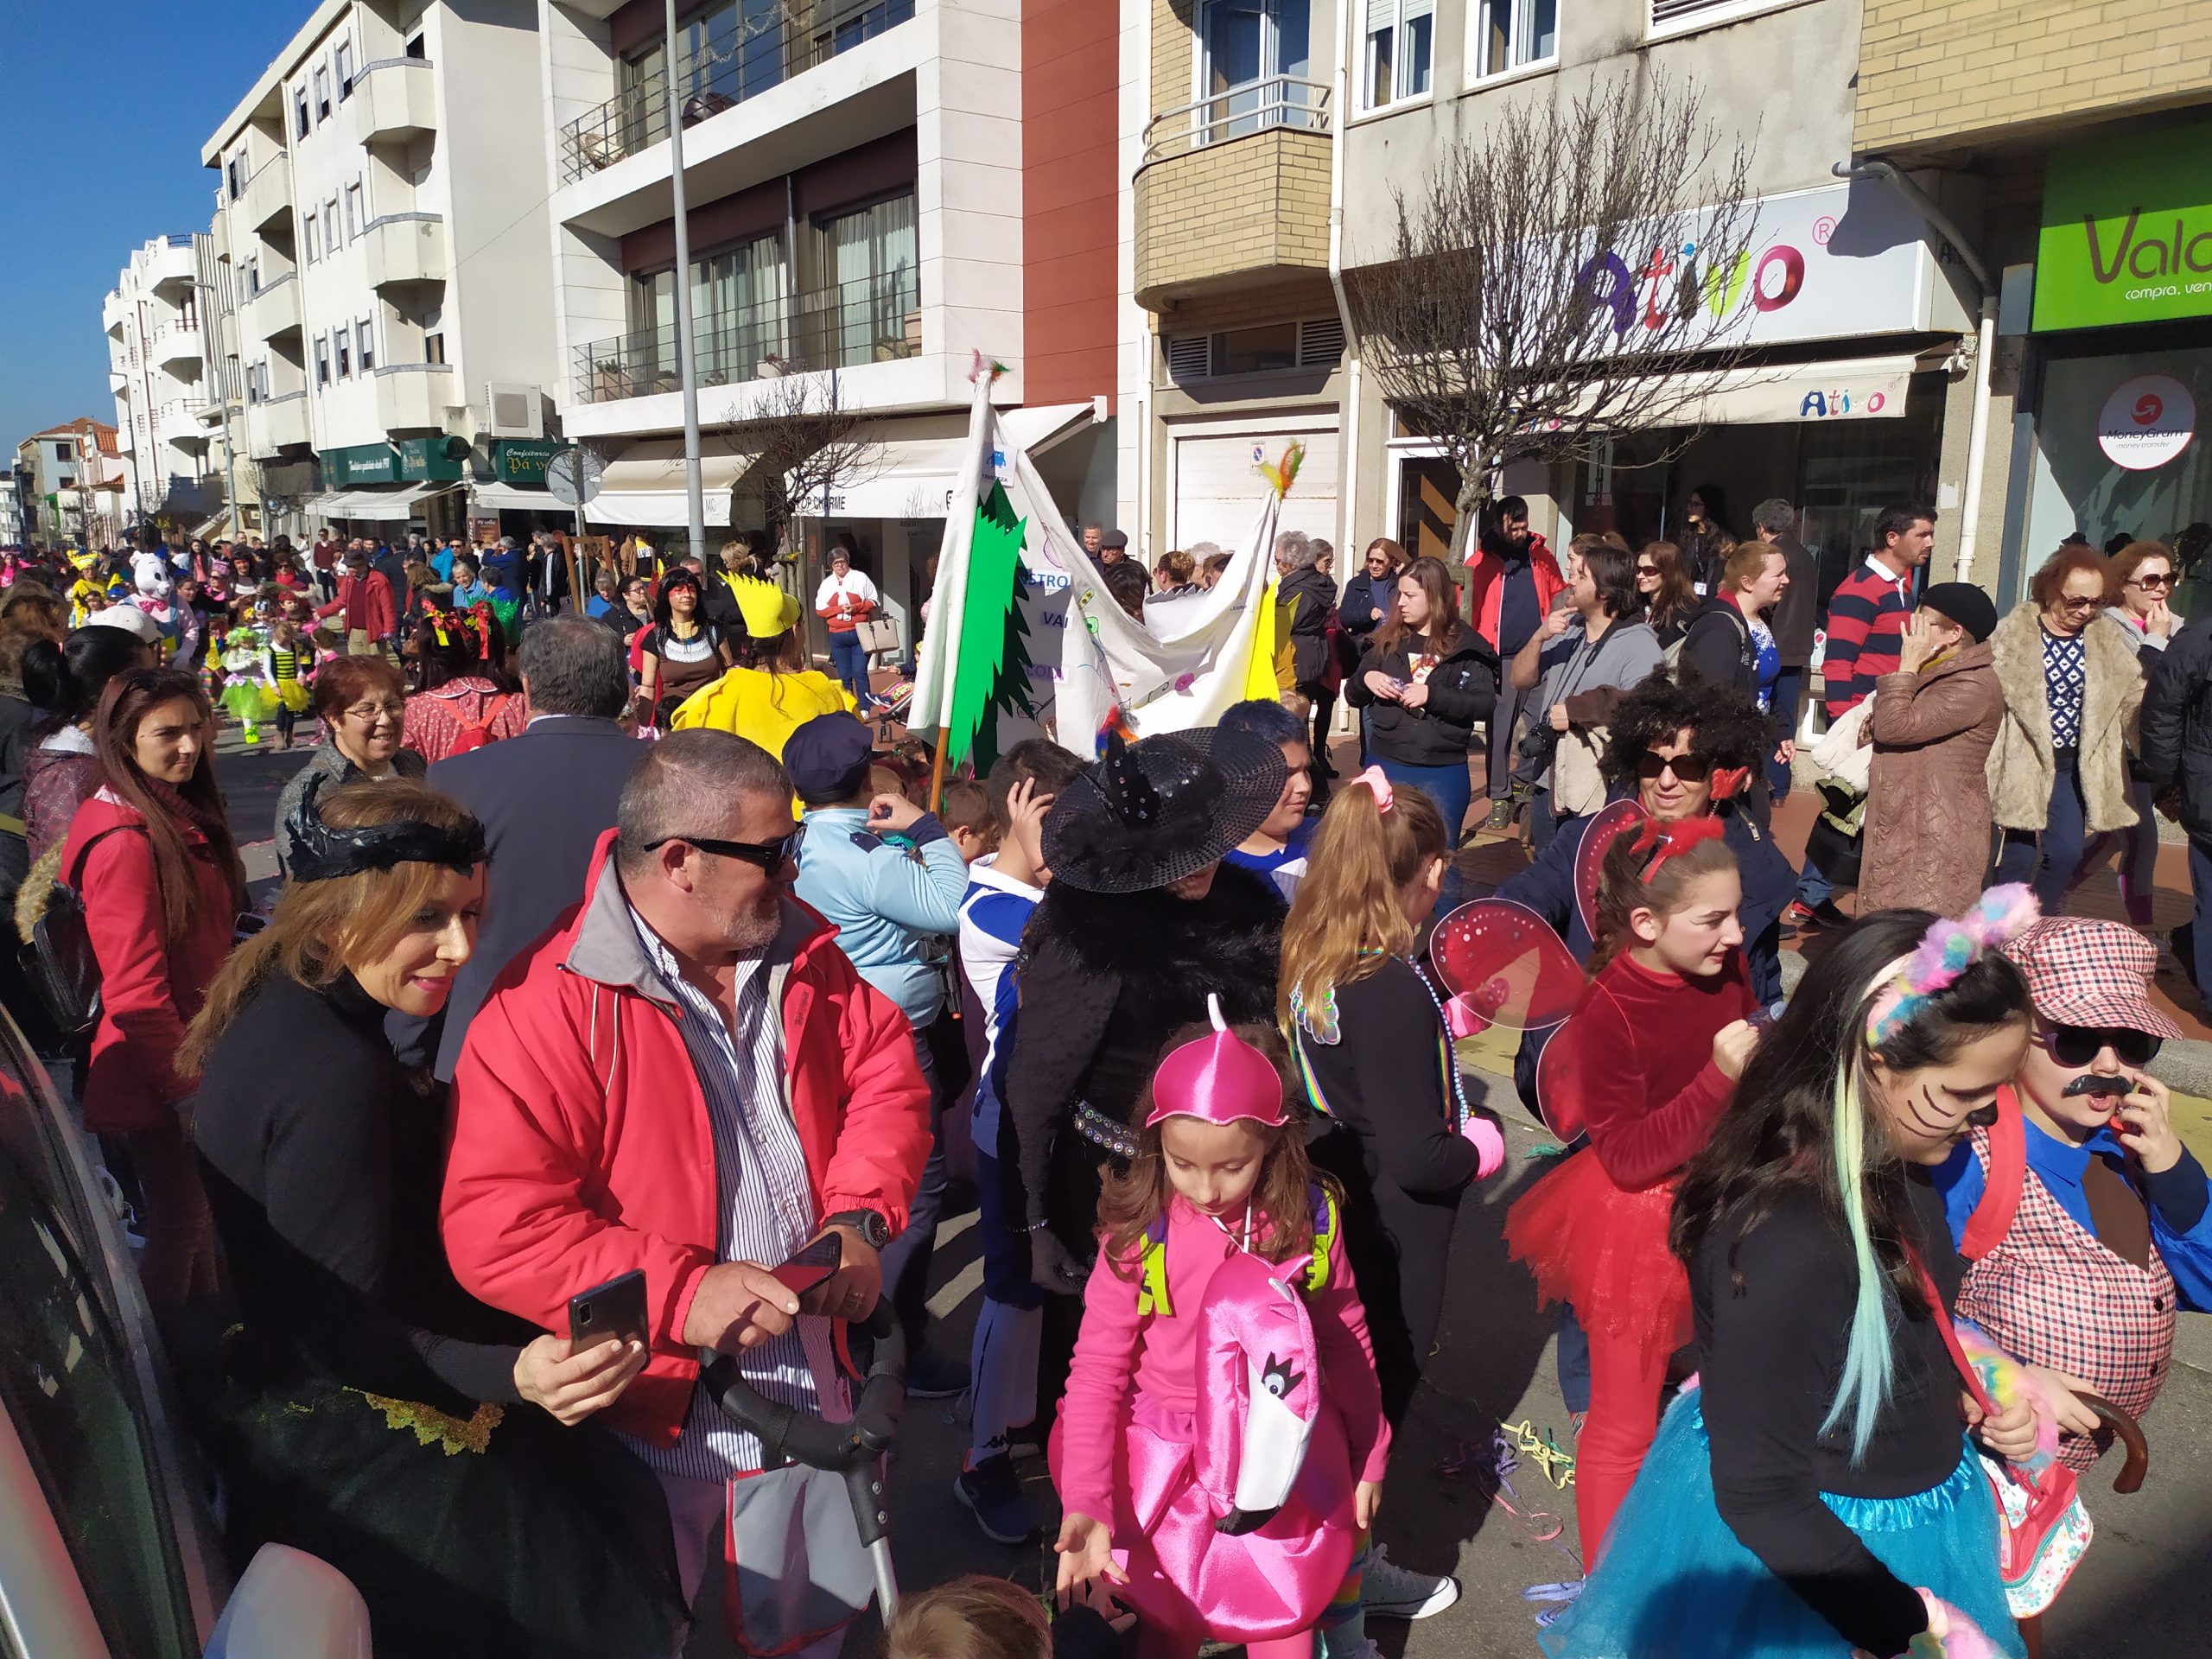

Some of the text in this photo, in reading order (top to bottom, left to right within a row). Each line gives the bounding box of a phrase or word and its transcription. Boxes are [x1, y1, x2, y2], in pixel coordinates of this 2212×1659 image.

[2106, 428, 2184, 442] MoneyGram
[2141, 440, 2171, 448] transfer
[1043, 611, 1069, 629] VAI
